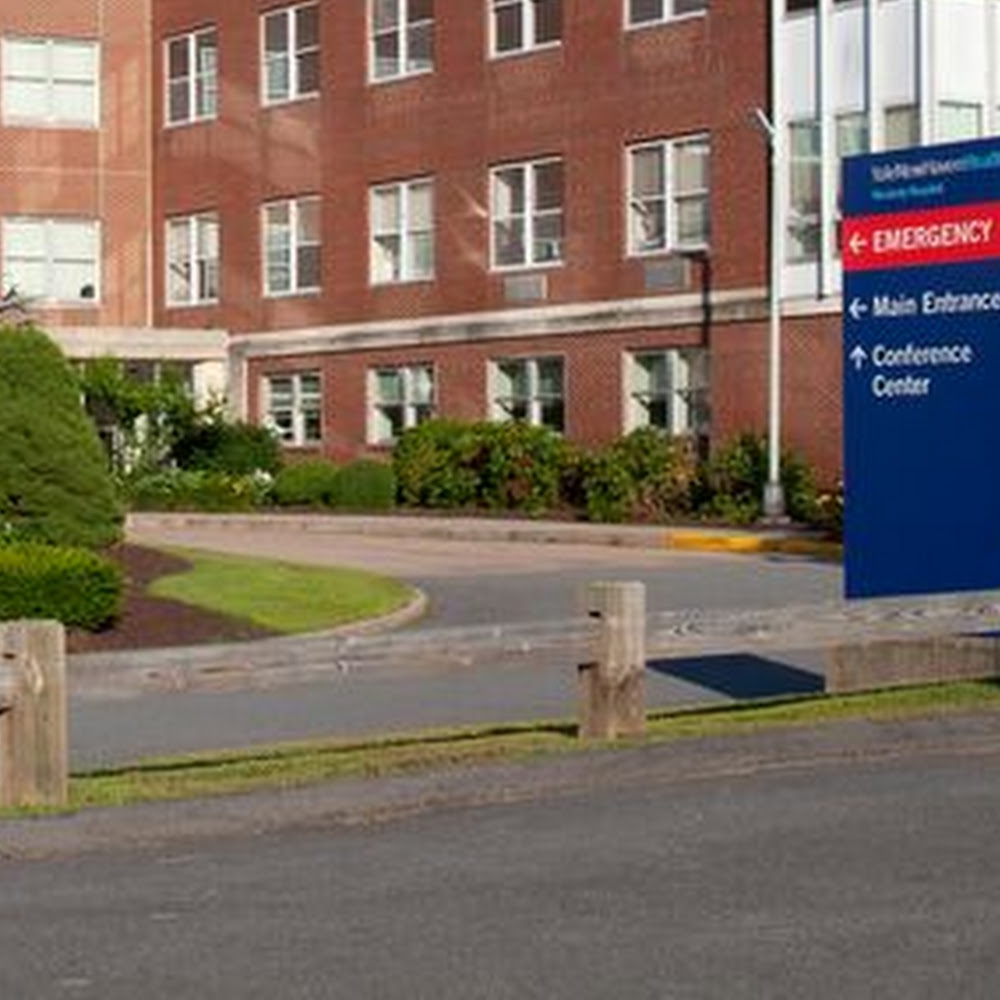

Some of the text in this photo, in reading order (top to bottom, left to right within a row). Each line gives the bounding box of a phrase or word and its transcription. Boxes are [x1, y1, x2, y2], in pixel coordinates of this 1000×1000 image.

[872, 218, 994, 254] EMERGENCY
[872, 290, 1000, 317] Main Entrance
[872, 342, 973, 367] Conference
[872, 374, 931, 398] Center
